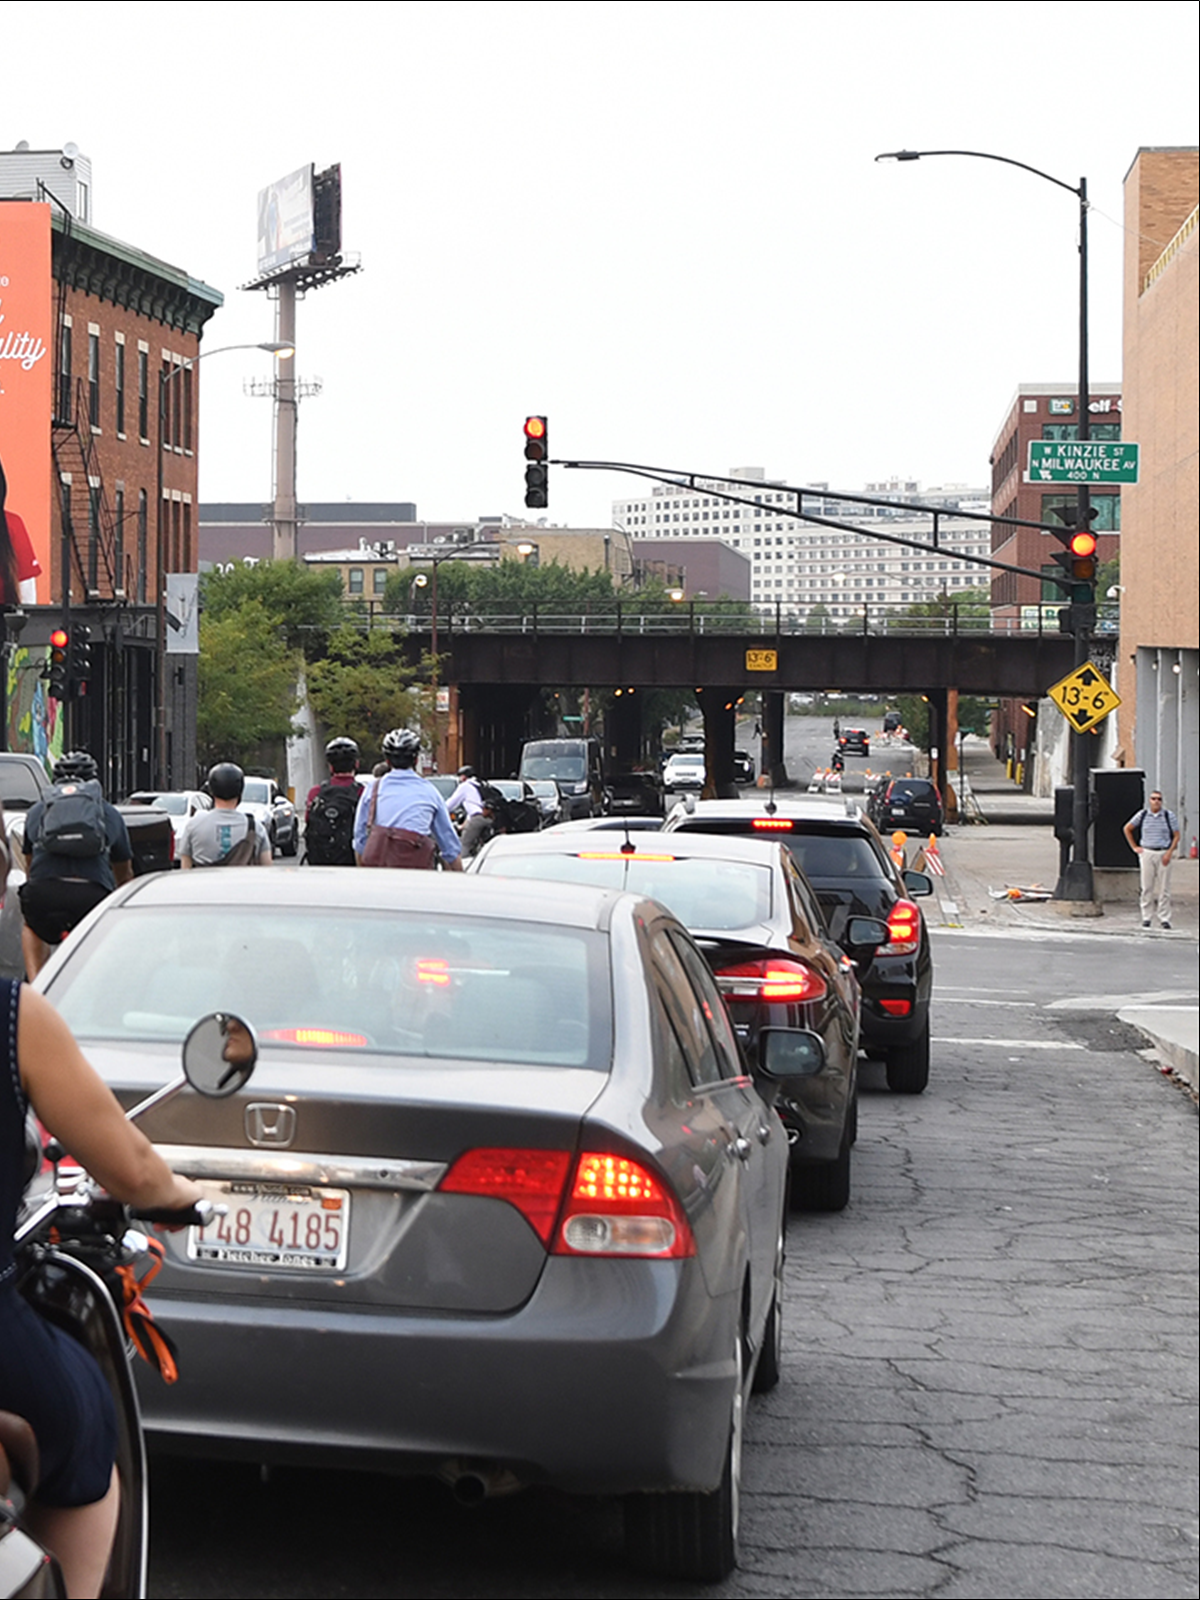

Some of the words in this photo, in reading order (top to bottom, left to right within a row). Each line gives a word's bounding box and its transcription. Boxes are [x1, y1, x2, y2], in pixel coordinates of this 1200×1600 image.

[1043, 446, 1052, 455] W
[1057, 445, 1107, 458] KINZIE
[1113, 447, 1125, 456] ST
[1032, 459, 1039, 468] N
[1042, 458, 1120, 471] MILWAUKEE
[1123, 460, 1136, 470] AV
[1067, 471, 1087, 480] 400
[1093, 471, 1100, 480] N
[269, 1210, 341, 1251] 4185
